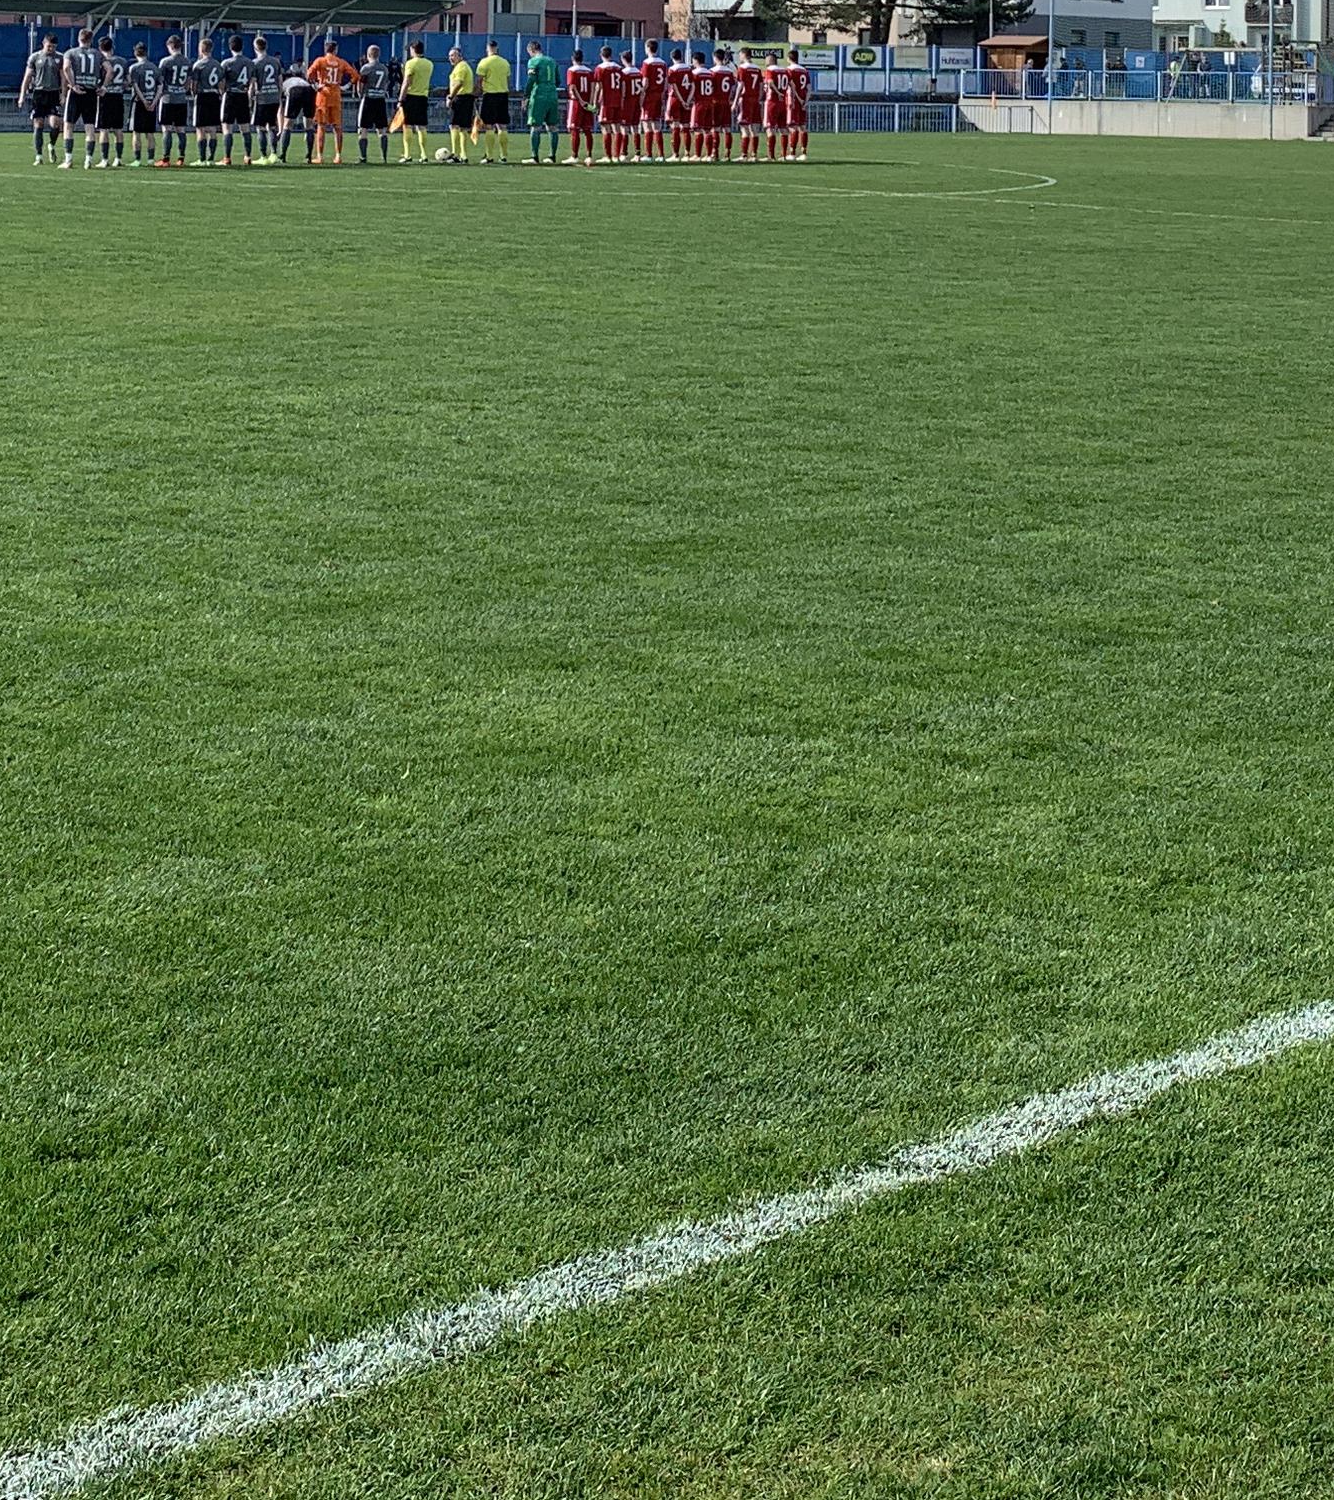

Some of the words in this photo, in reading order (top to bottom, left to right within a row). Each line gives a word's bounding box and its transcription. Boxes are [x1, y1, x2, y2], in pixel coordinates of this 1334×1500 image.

[79, 53, 95, 74] 11
[145, 70, 155, 89] 5
[172, 65, 188, 85] 15
[208, 67, 218, 86] 6
[237, 66, 248, 85] 4
[264, 64, 275, 83] 2
[326, 67, 339, 85] 31
[375, 71, 384, 88] 7
[611, 72, 621, 89] 13
[655, 68, 664, 85] 3
[681, 74, 691, 90] 4
[751, 74, 758, 89] 7
[777, 74, 788, 90] 10
[799, 74, 807, 89] 9
[580, 76, 587, 92] 11
[631, 79, 642, 96] 15
[700, 80, 713, 96] 18
[721, 76, 730, 92] 6
